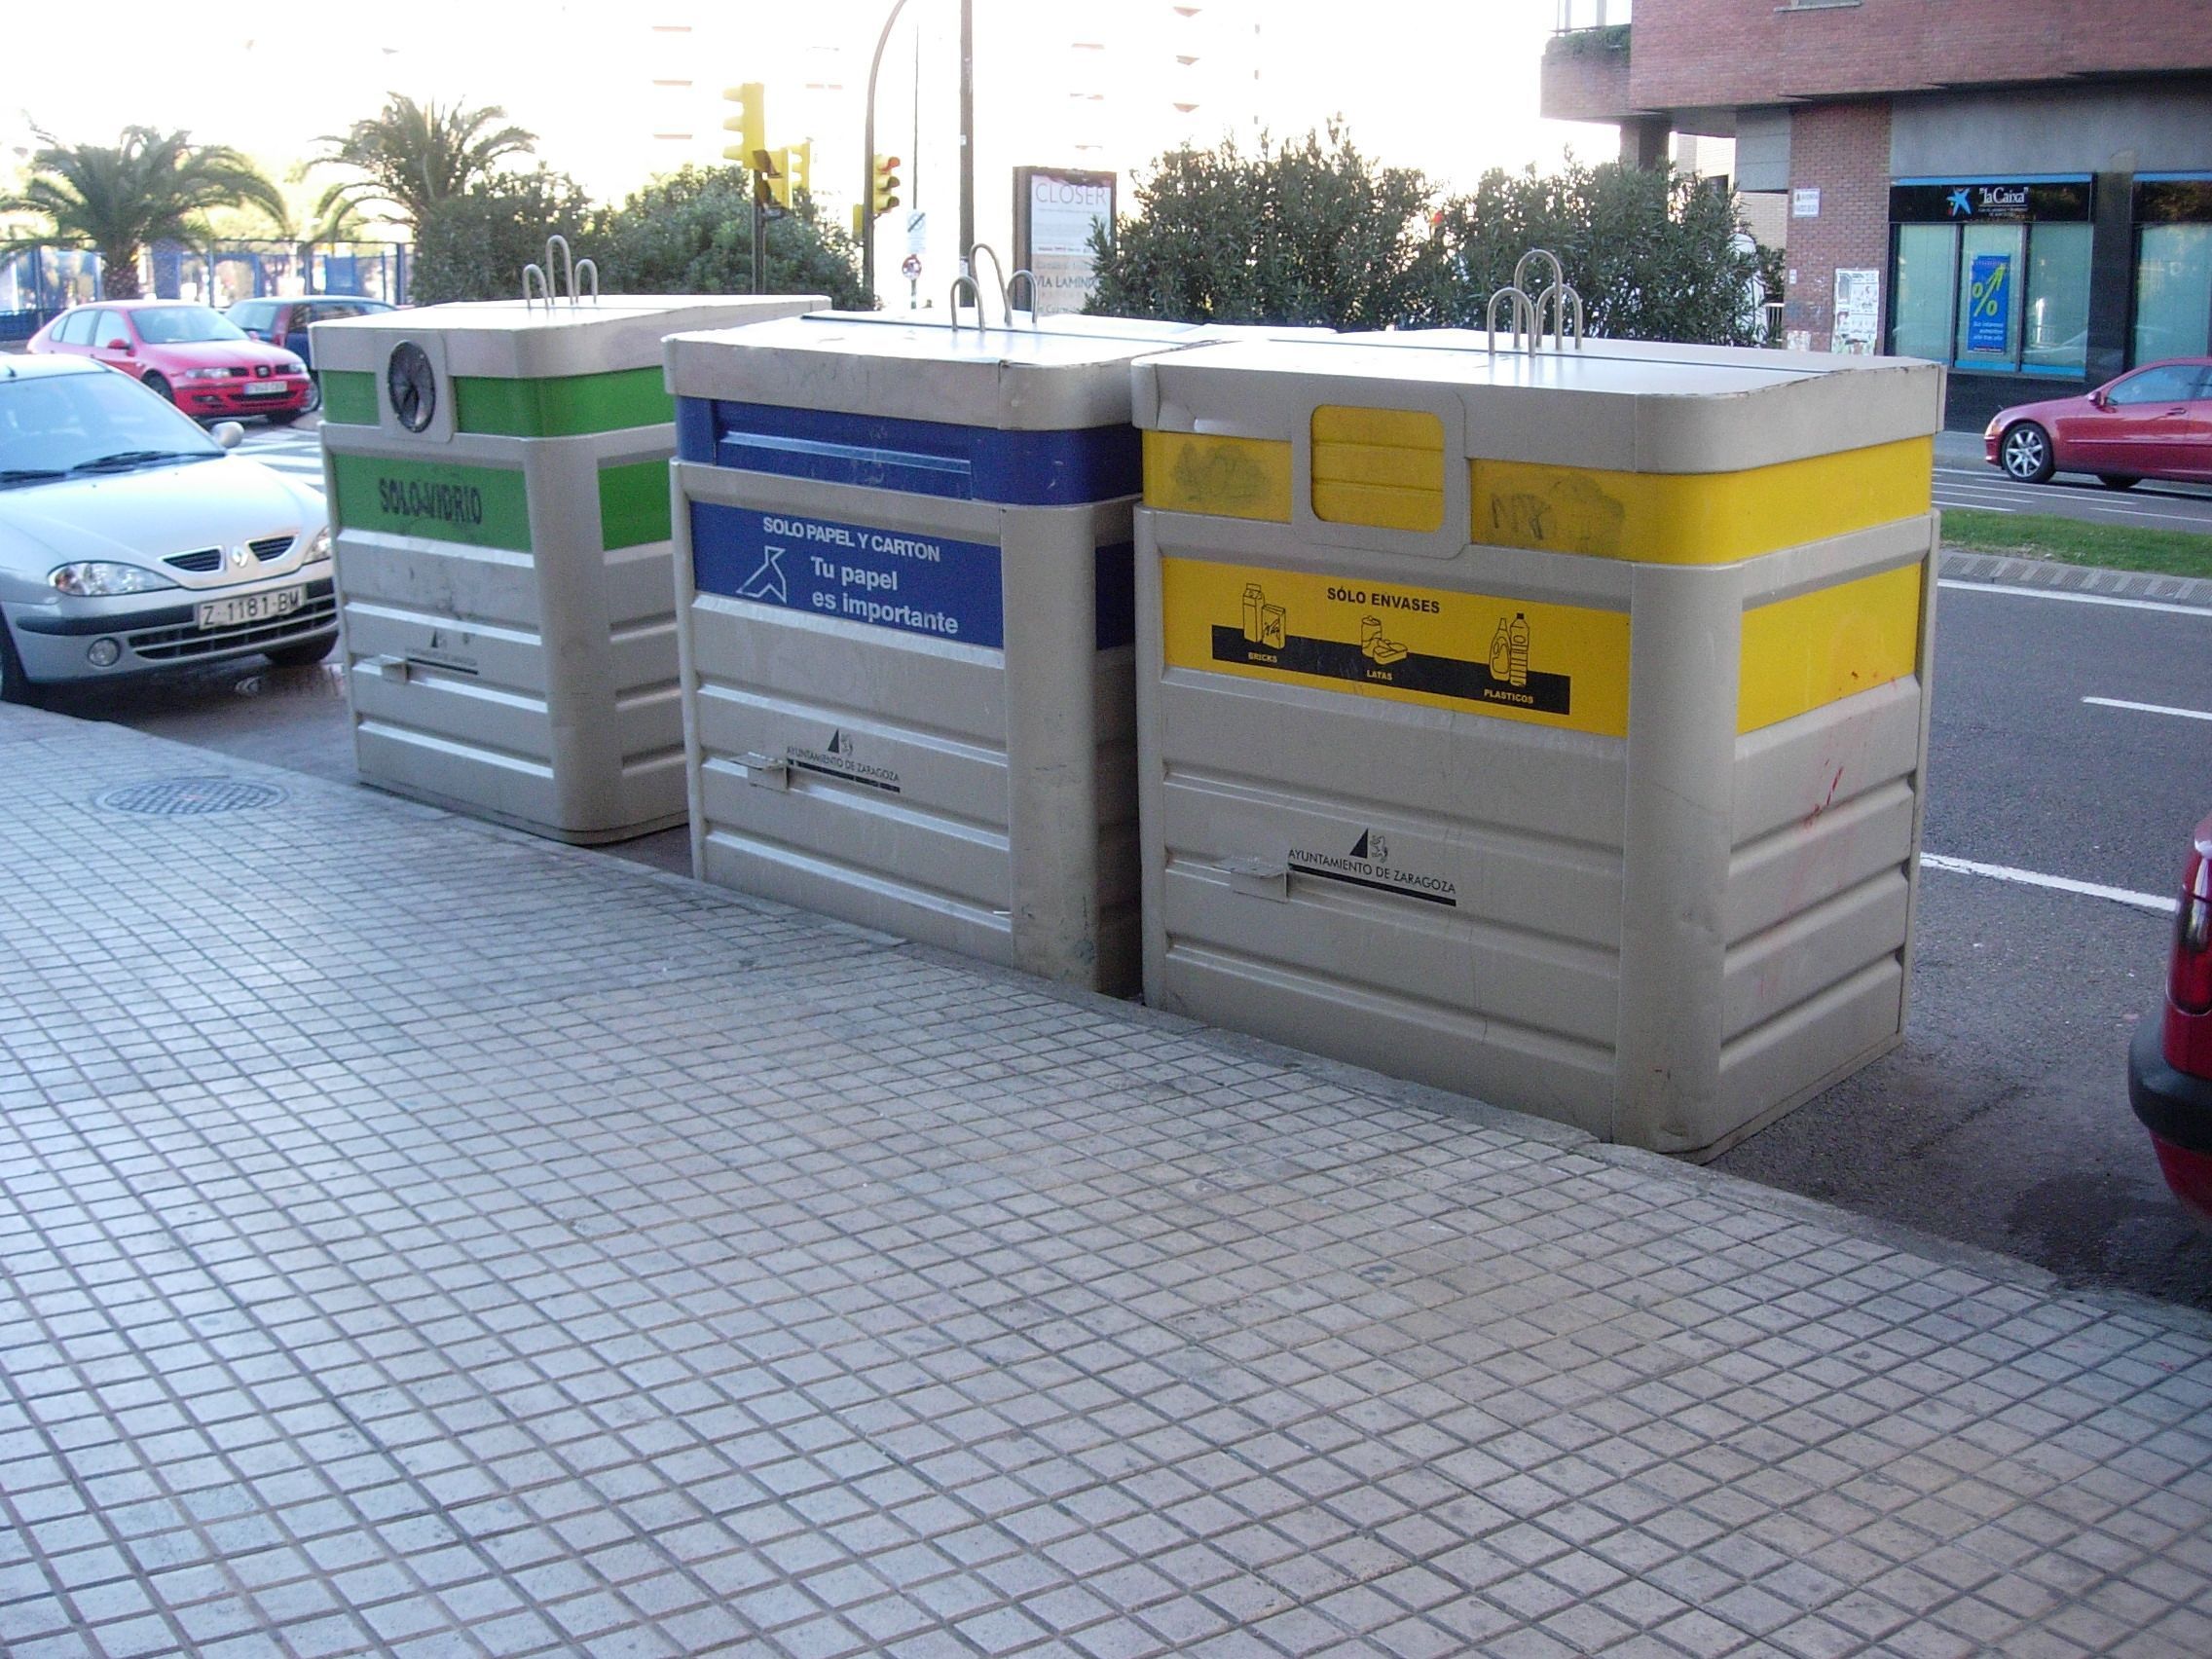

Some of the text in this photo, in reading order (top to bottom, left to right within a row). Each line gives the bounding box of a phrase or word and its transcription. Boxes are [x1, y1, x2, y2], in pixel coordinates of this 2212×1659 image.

[1036, 183, 1106, 205] CLOSER
[763, 516, 940, 563] SOLO PAPEL Y CARTON
[810, 556, 898, 591] Tu papel
[812, 590, 959, 634] es importante
[1327, 586, 1440, 614] SÓLO ENVASES
[1247, 651, 1278, 664] BRICKS
[1366, 669, 1393, 682] LATAS
[1484, 687, 1534, 705] PLASTICOS
[786, 746, 900, 782] AYUNTAMIENTO DE ZARAGOZA
[1288, 848, 1456, 895] AYUNTAMIENTO DE ZARAGOZA
